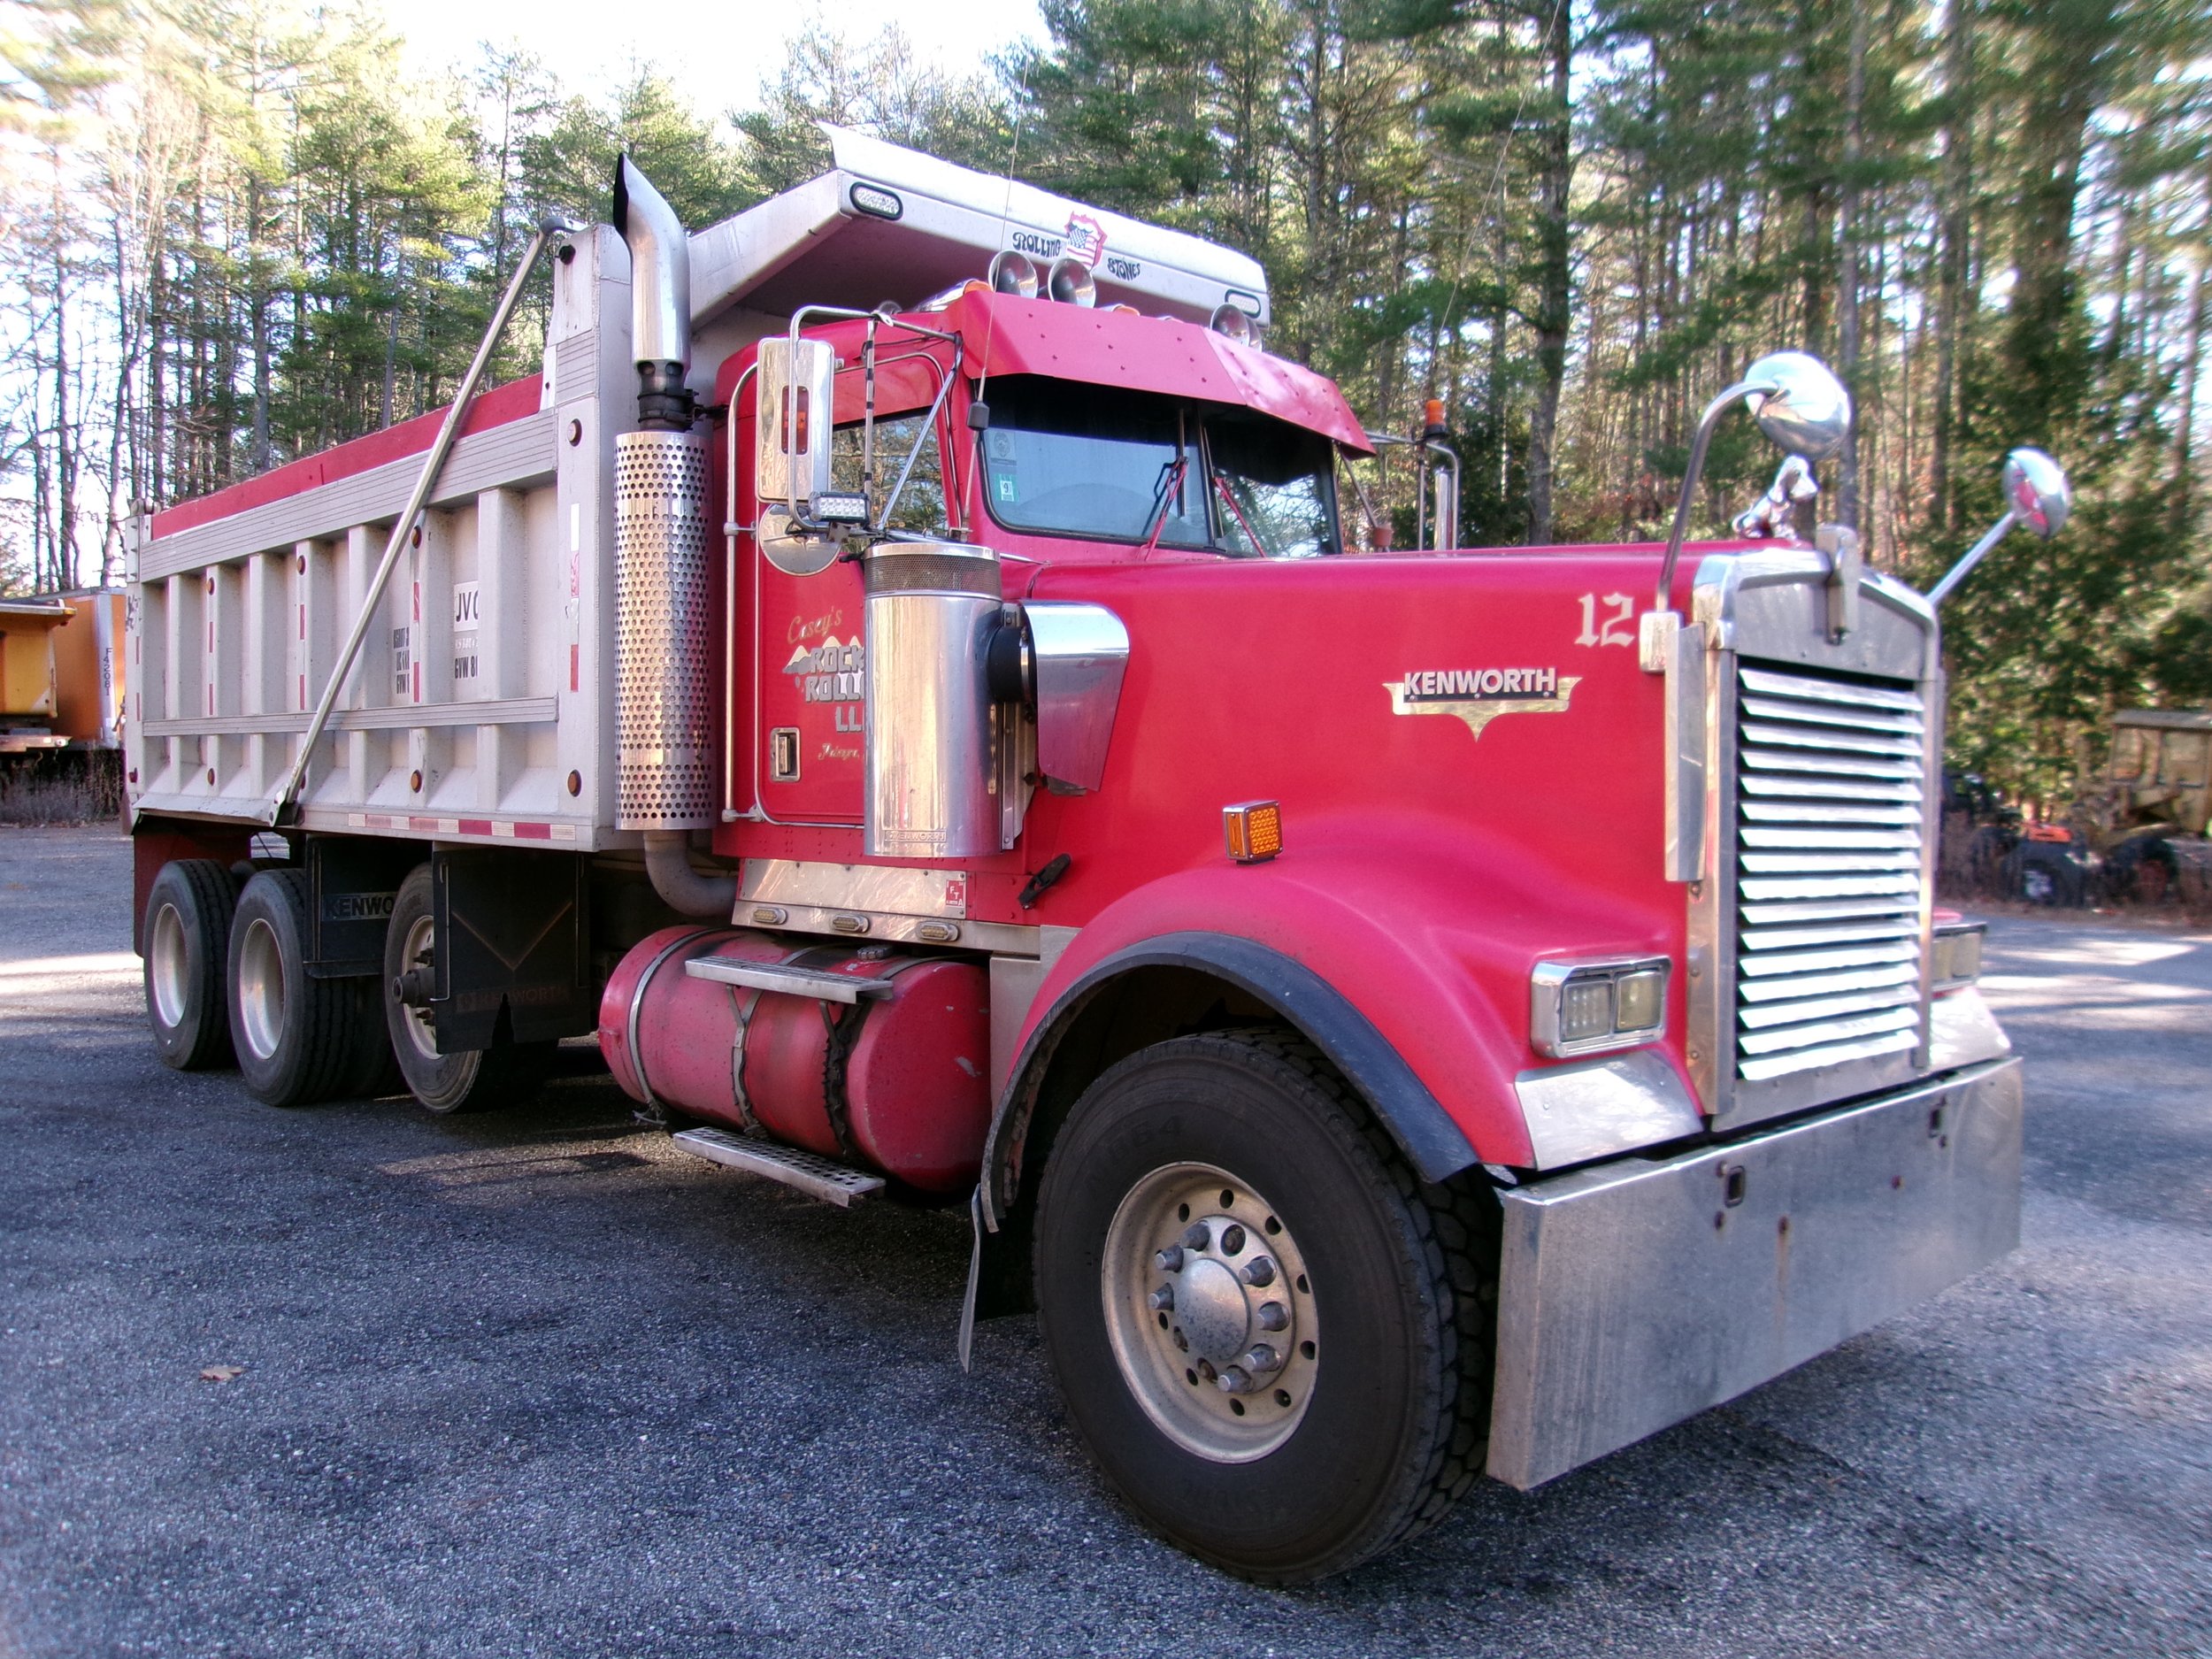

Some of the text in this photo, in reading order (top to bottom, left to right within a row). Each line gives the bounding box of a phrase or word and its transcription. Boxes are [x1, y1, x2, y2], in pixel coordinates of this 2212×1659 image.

[1108, 257, 1141, 281] STONES
[787, 606, 842, 644] Casey's
[1574, 592, 1634, 647] 12
[1404, 668, 1556, 695] KENWORTH
[835, 706, 864, 733] LL
